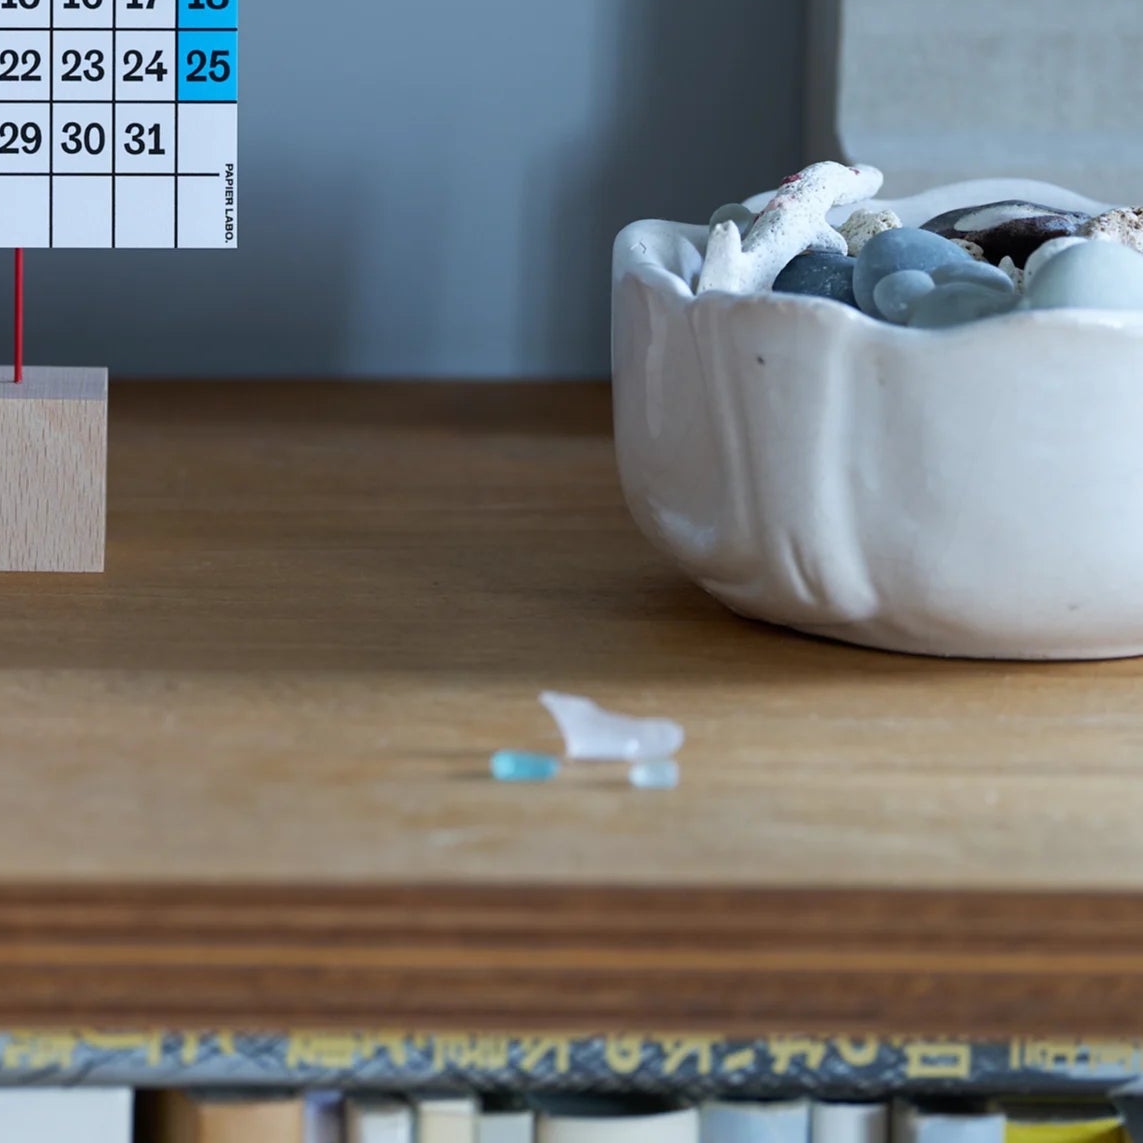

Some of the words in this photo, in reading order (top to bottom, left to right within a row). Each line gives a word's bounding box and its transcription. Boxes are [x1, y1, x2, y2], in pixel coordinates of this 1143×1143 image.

[61, 49, 105, 82] 23
[122, 49, 168, 82] 24
[186, 49, 230, 82] 25
[61, 121, 105, 155] 30
[124, 122, 166, 155] 31
[224, 163, 234, 206] PAPIER
[224, 208, 234, 244] LABO.
